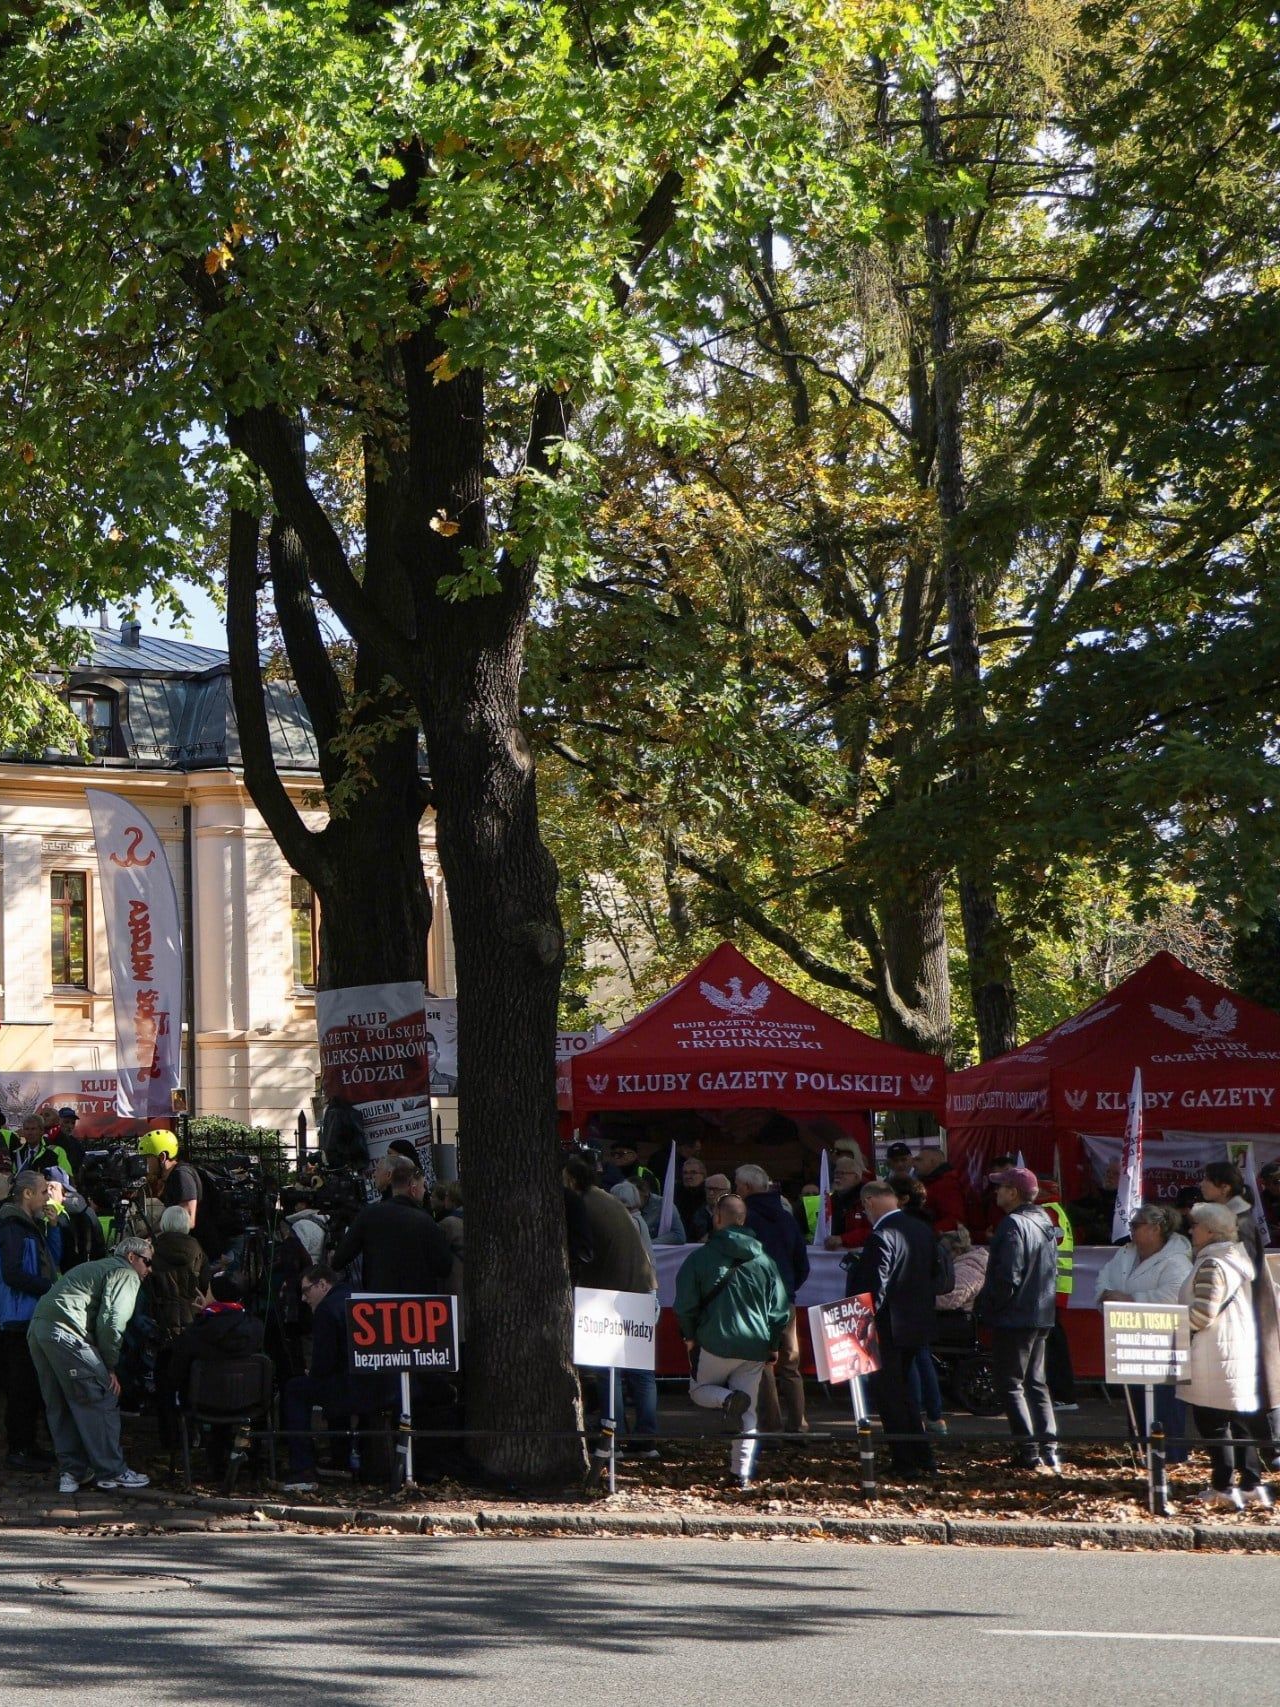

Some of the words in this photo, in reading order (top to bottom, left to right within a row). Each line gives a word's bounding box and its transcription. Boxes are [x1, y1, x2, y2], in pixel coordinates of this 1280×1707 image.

[347, 1012, 388, 1028] KLUB
[673, 1021, 706, 1030] KLUB
[708, 1020, 754, 1029] GAZETY
[367, 1023, 427, 1042] POLSKIEJ
[691, 1028, 803, 1040] PIOTRKÓW
[677, 1040, 825, 1051] TRYBUNALSKI
[1192, 1042, 1250, 1052] KLUBY
[1150, 1053, 1219, 1063] GAZETY
[343, 1062, 407, 1086] ŁÓDZKI
[616, 1073, 691, 1093] KLUBY
[698, 1070, 788, 1091] GAZETY
[795, 1071, 904, 1097] POLSKIEJ
[1096, 1091, 1174, 1110] KLBY
[1181, 1087, 1276, 1109] GAZETY
[352, 1301, 449, 1346] STOP
[578, 1315, 655, 1343] #StopPatoWładzy
[1110, 1311, 1142, 1329] DZIEŁA
[1142, 1312, 1172, 1330] TUSKA
[354, 1349, 412, 1371] bezprawiu
[412, 1347, 451, 1367] Tuska!
